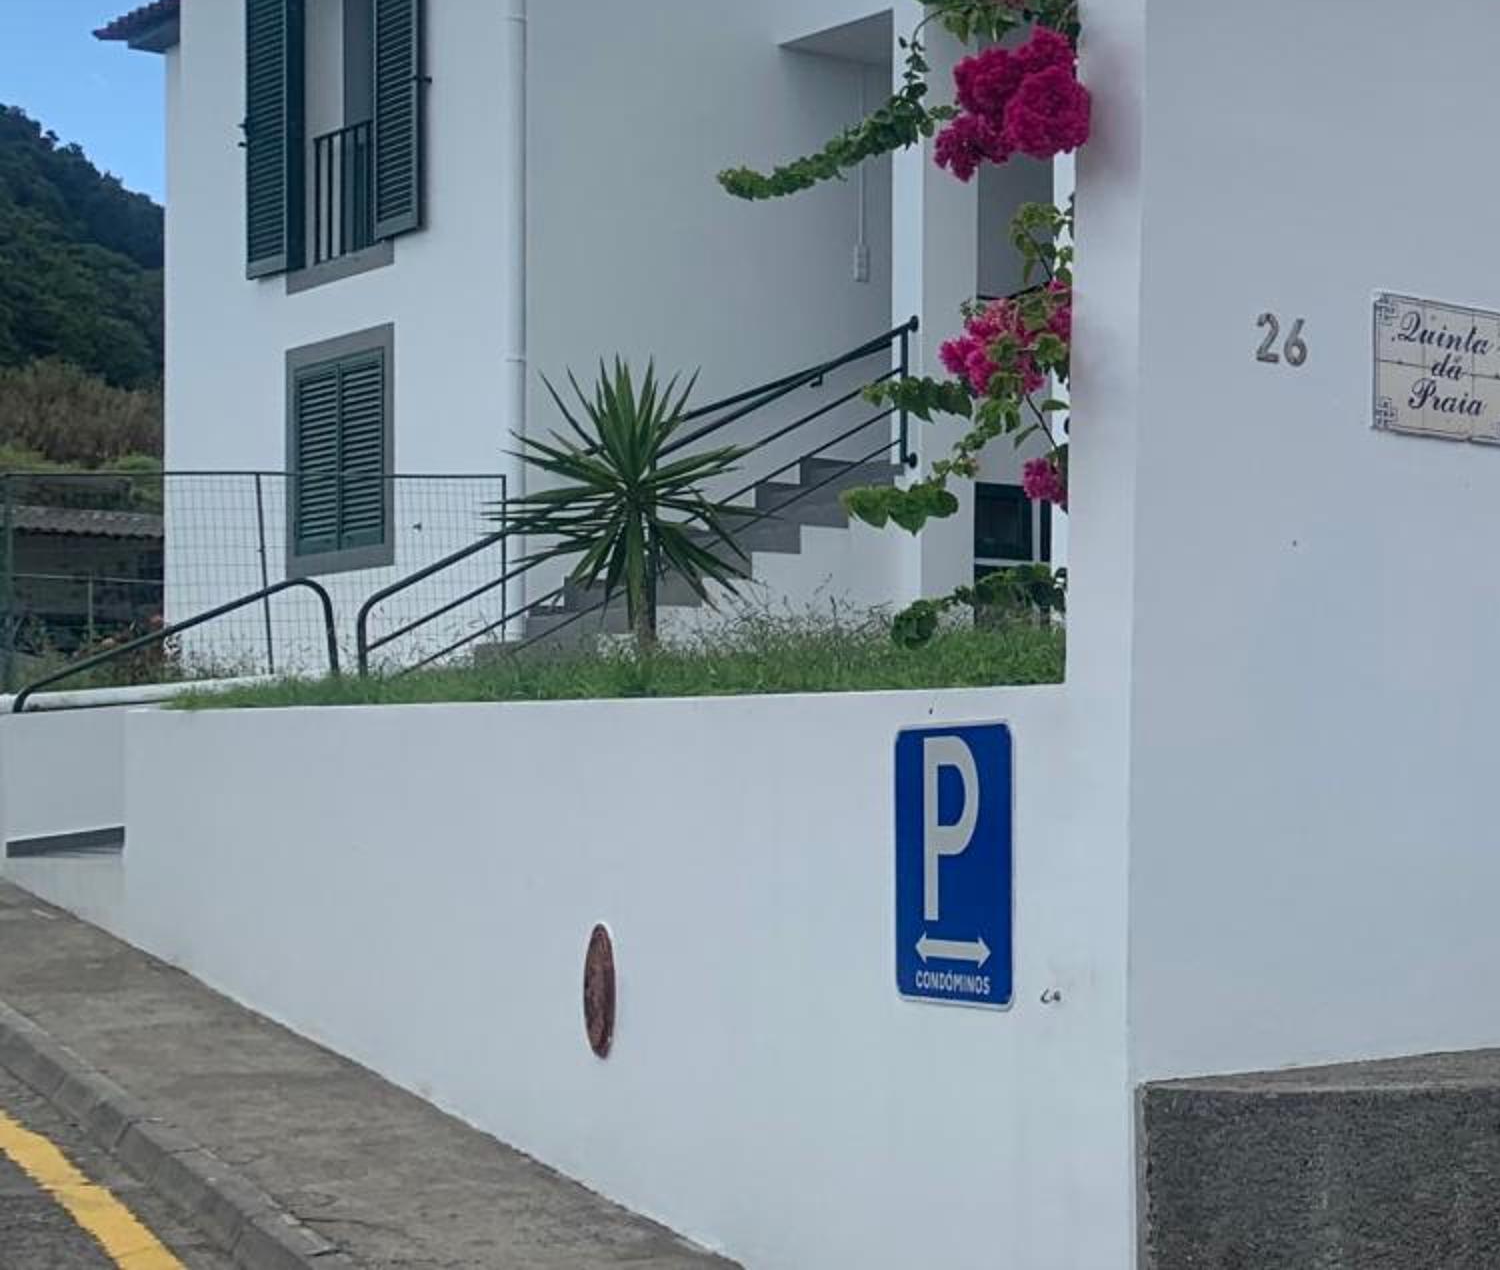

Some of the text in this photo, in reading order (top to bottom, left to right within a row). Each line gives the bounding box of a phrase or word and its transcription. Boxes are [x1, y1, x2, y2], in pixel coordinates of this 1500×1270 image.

[1256, 313, 1308, 367] 26
[1394, 310, 1490, 355] Quinta
[1407, 378, 1485, 416] Praia
[923, 735, 979, 921] P
[915, 969, 991, 995] CONDÓMINOS
